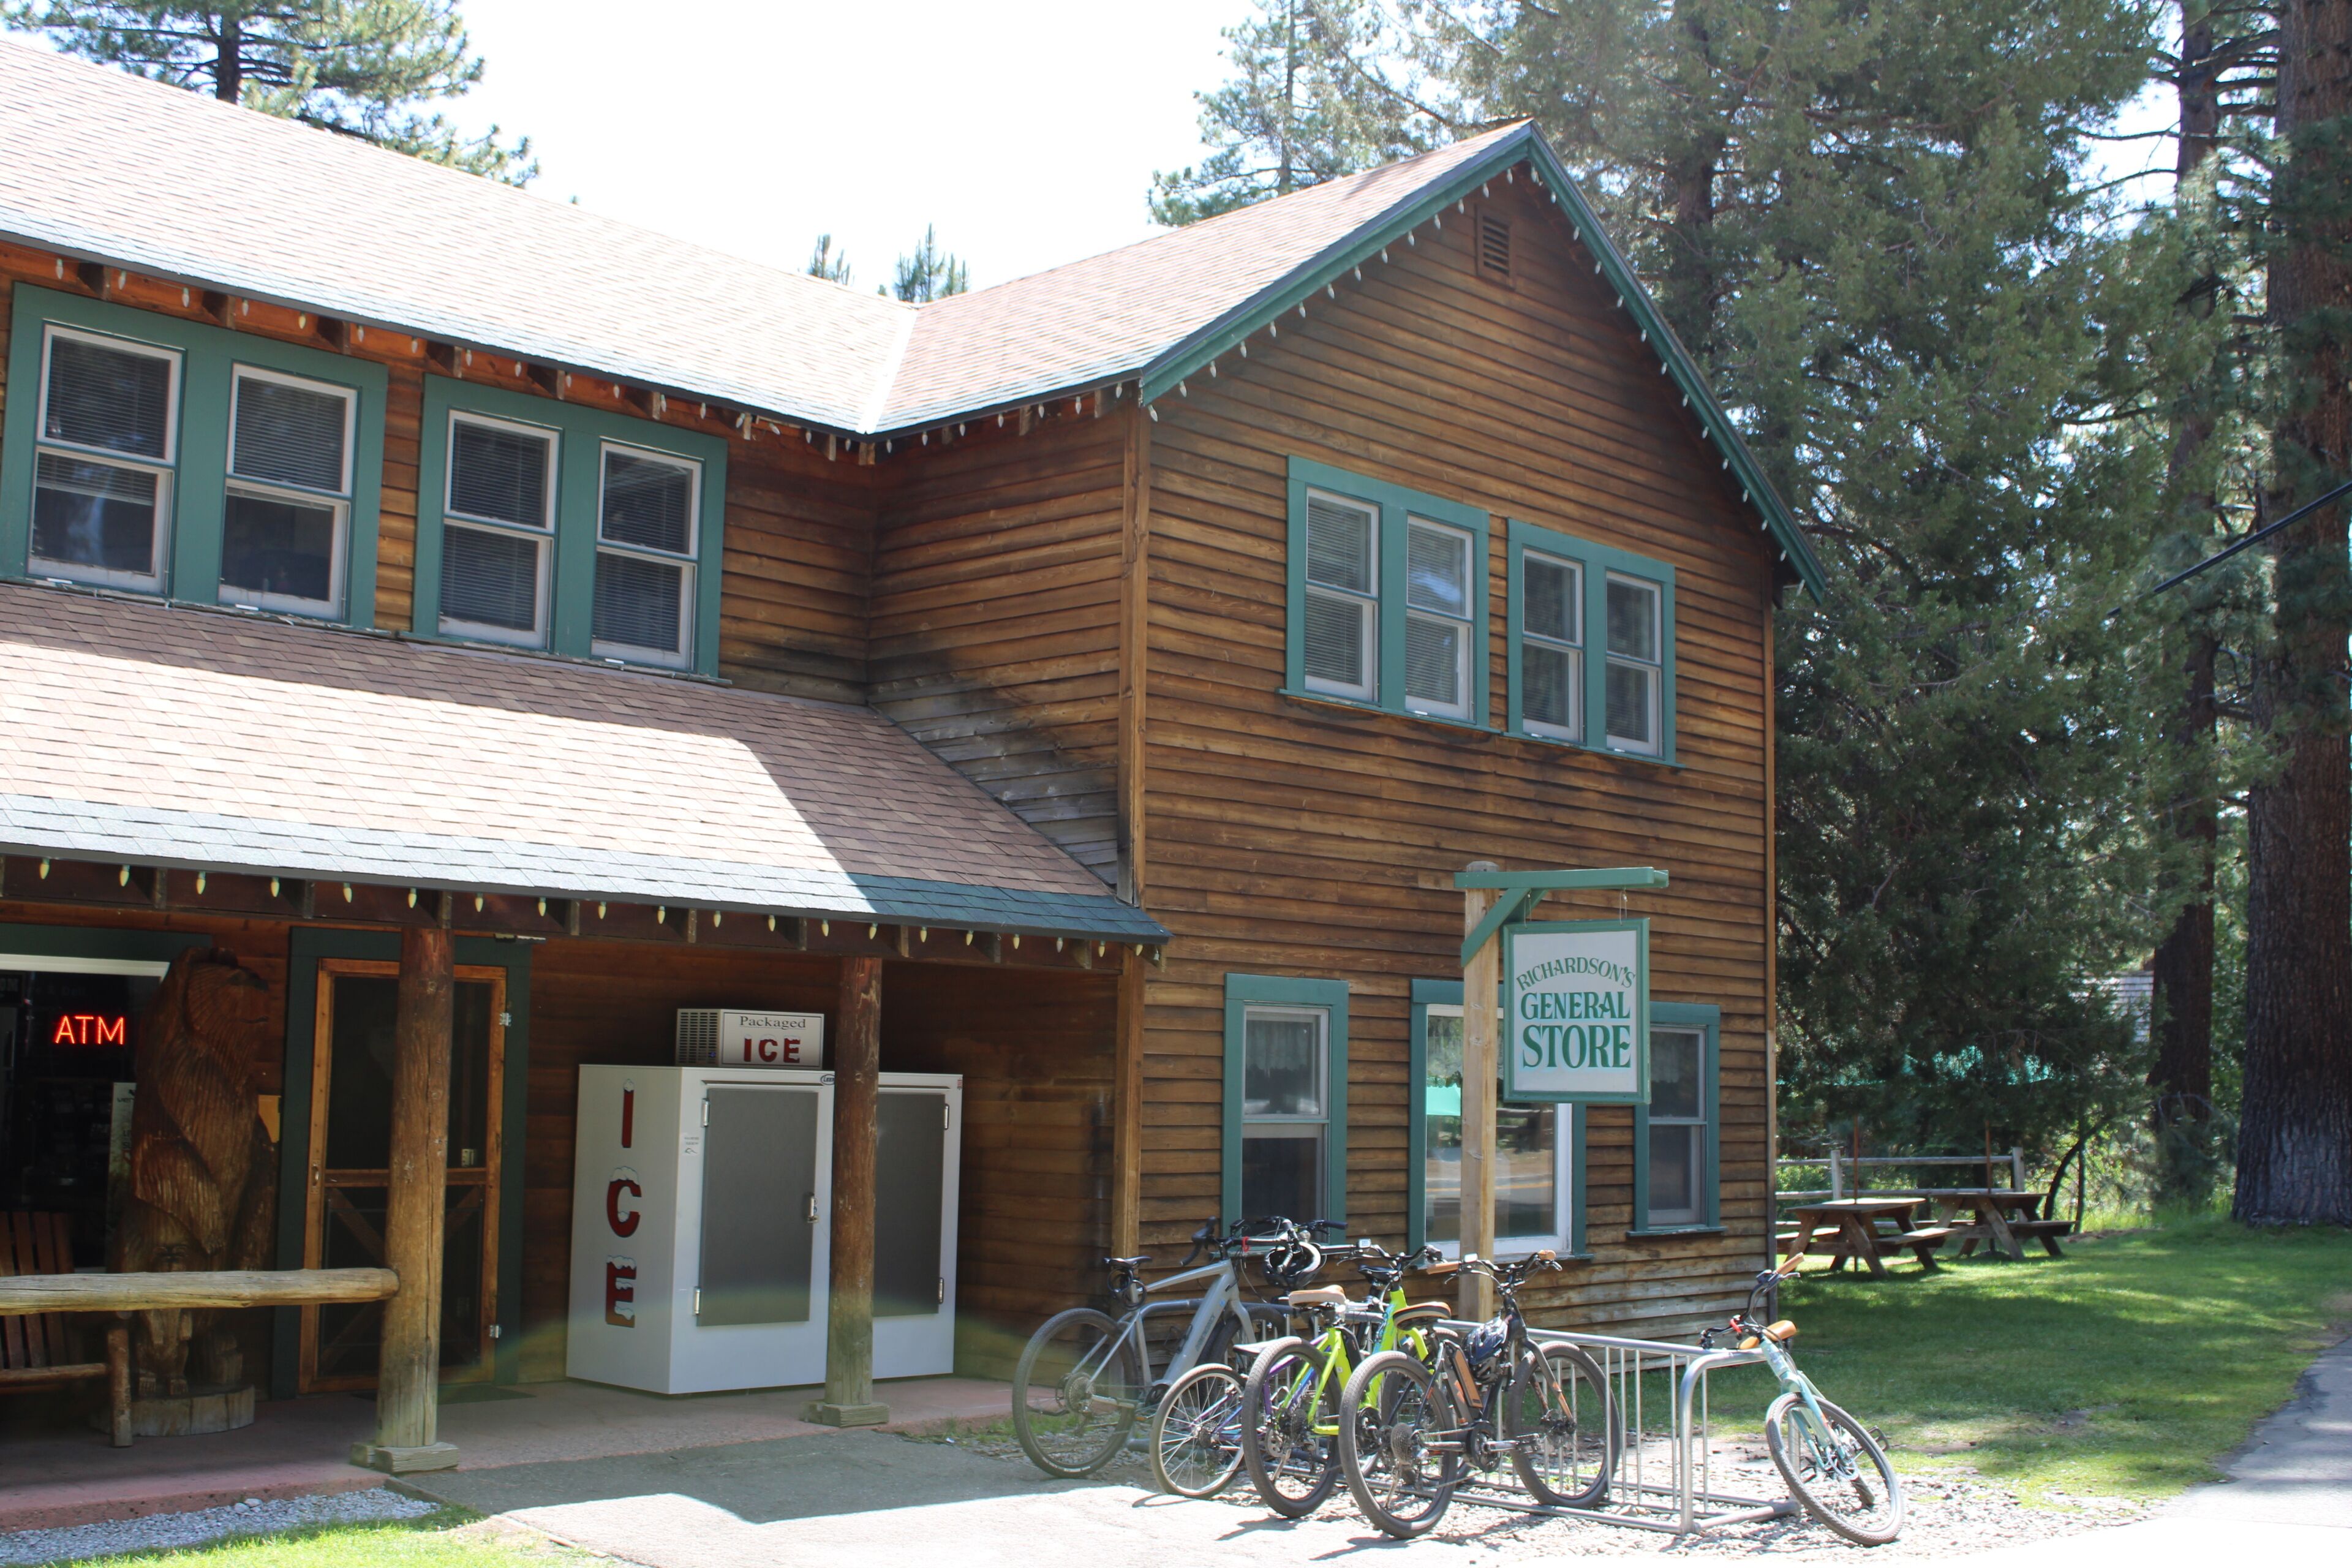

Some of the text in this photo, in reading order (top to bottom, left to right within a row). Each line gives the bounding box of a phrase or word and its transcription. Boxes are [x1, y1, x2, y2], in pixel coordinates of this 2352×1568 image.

[1516, 957, 1636, 990] RICHARDSON'S
[1521, 992, 1630, 1020] GENERAL
[55, 1014, 124, 1045] ATM
[740, 1016, 806, 1030] Packaged
[744, 1035, 801, 1063] ICE
[1523, 1024, 1630, 1068] STORE
[605, 1079, 642, 1328] ICE
